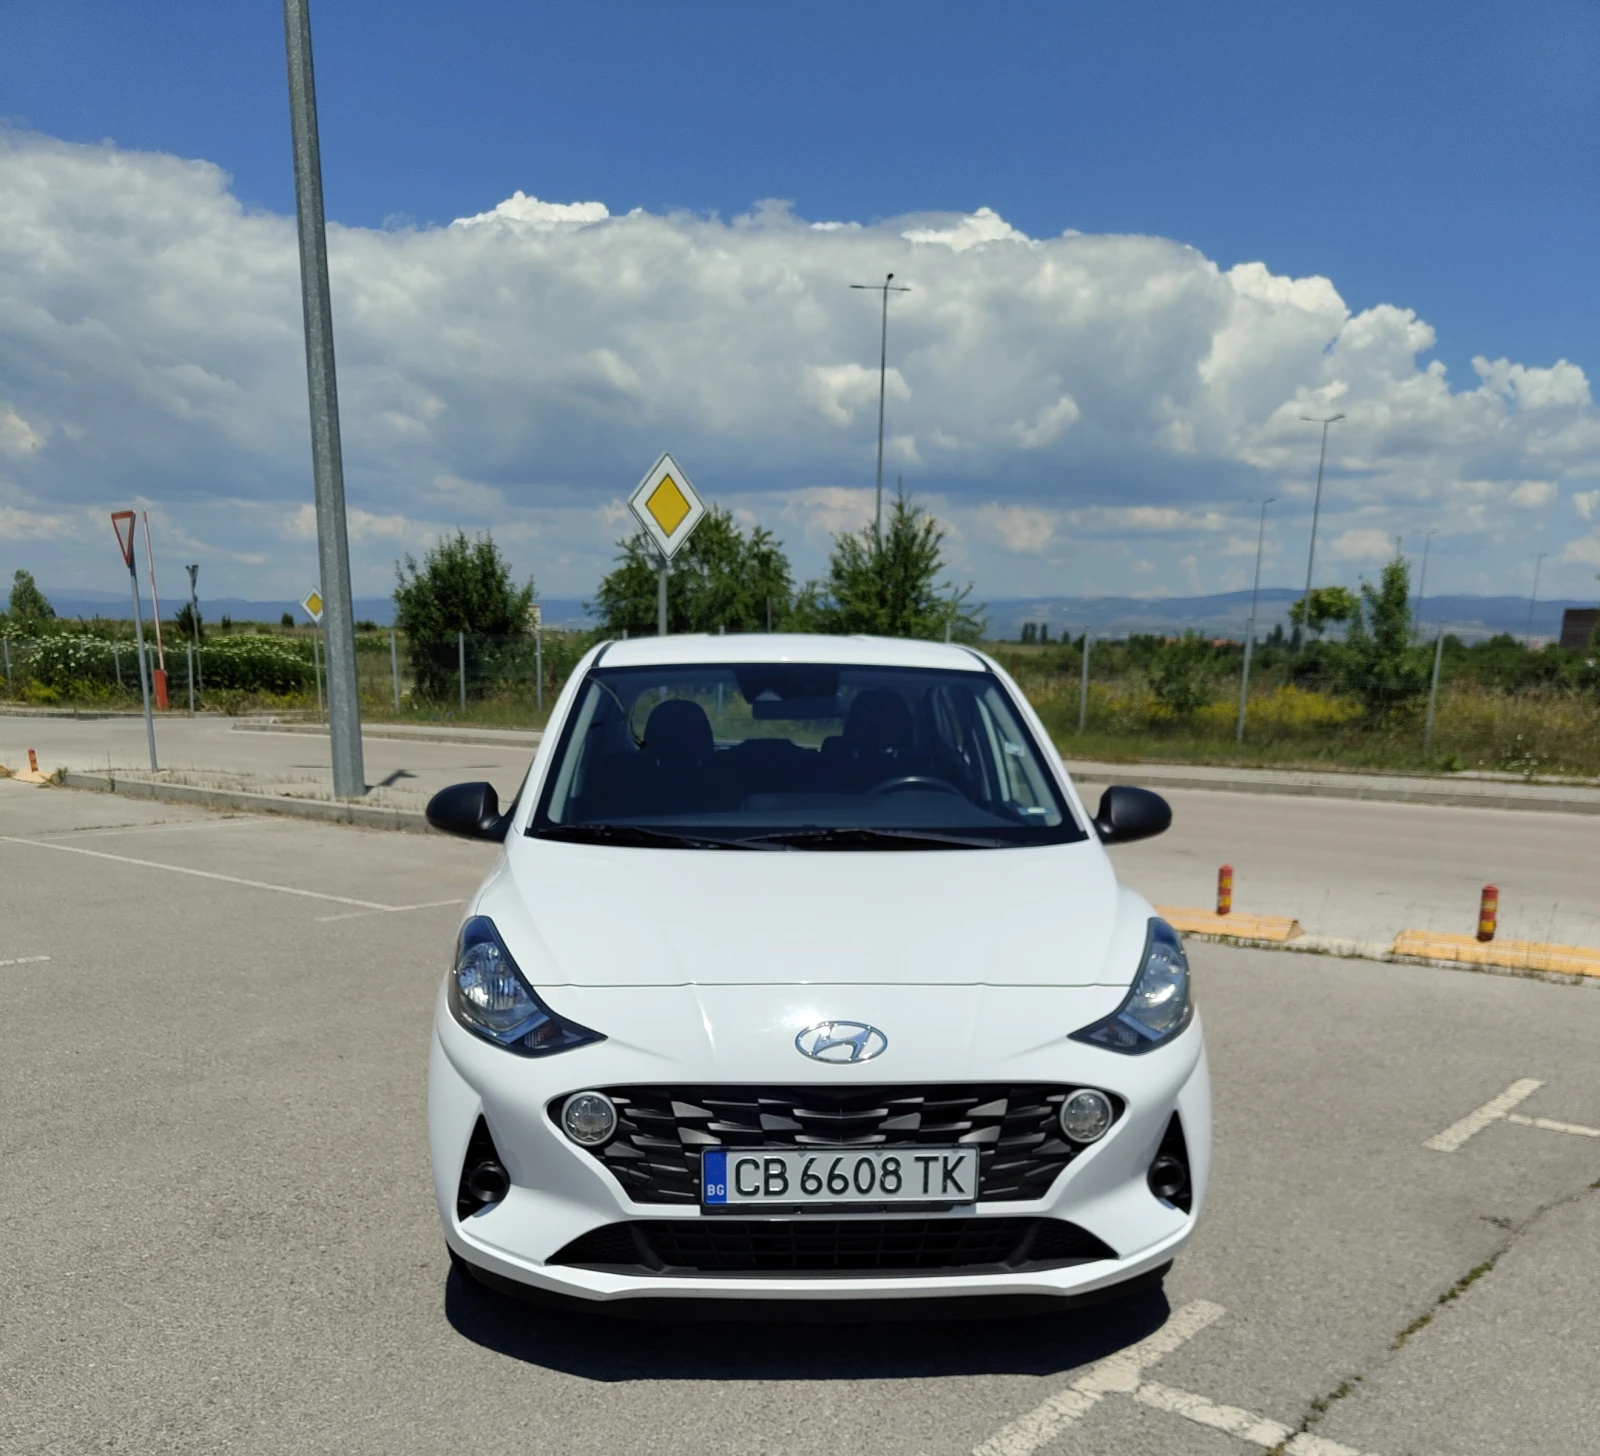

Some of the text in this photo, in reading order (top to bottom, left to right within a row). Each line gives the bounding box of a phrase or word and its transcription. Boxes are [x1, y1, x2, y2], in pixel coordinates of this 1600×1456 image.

[735, 1155, 966, 1196] CB 6608 TK
[707, 1184, 725, 1196] BG
